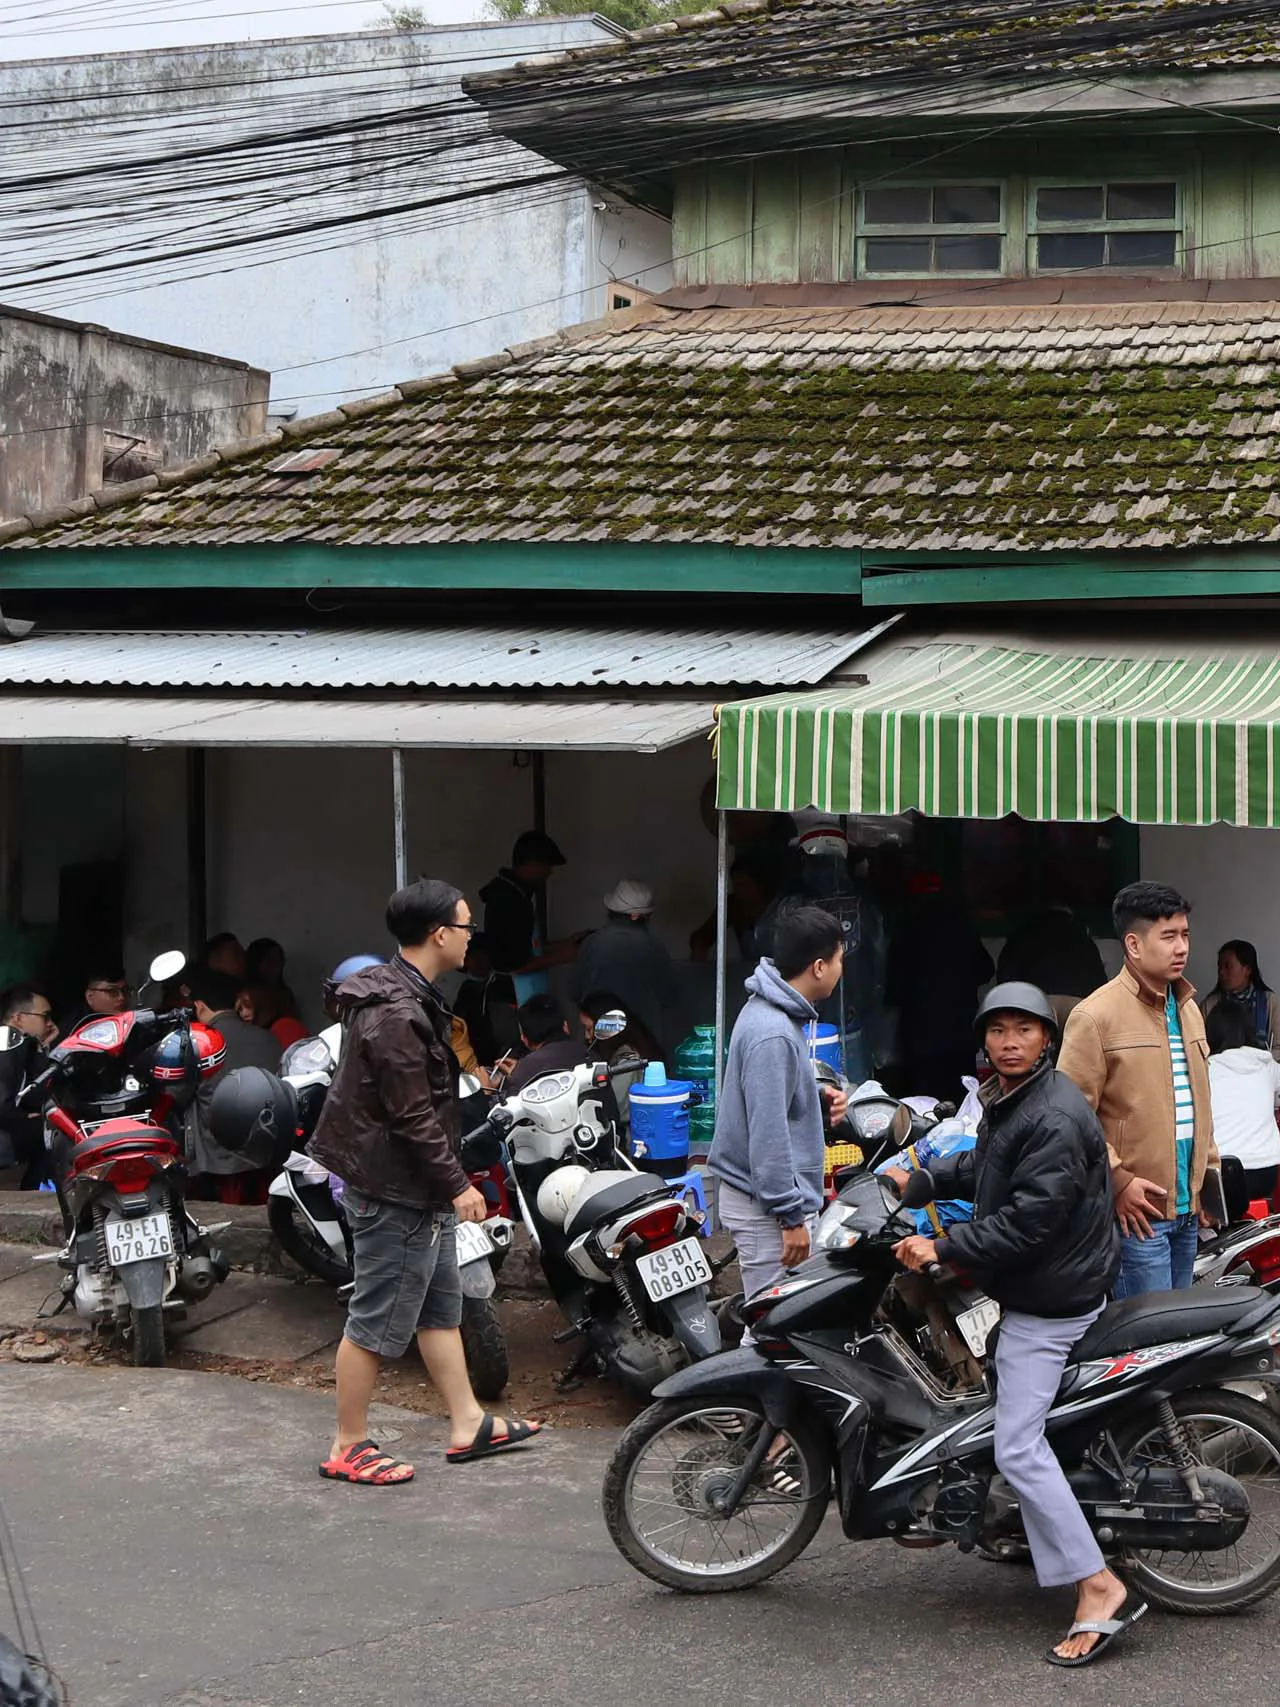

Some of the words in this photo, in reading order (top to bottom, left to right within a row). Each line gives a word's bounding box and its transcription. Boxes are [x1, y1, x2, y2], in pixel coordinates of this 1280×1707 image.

[117, 1217, 159, 1240] 49-E1
[112, 1235, 169, 1263] 078.26
[649, 1244, 692, 1275] 49-B1
[650, 1260, 707, 1297] 089.05
